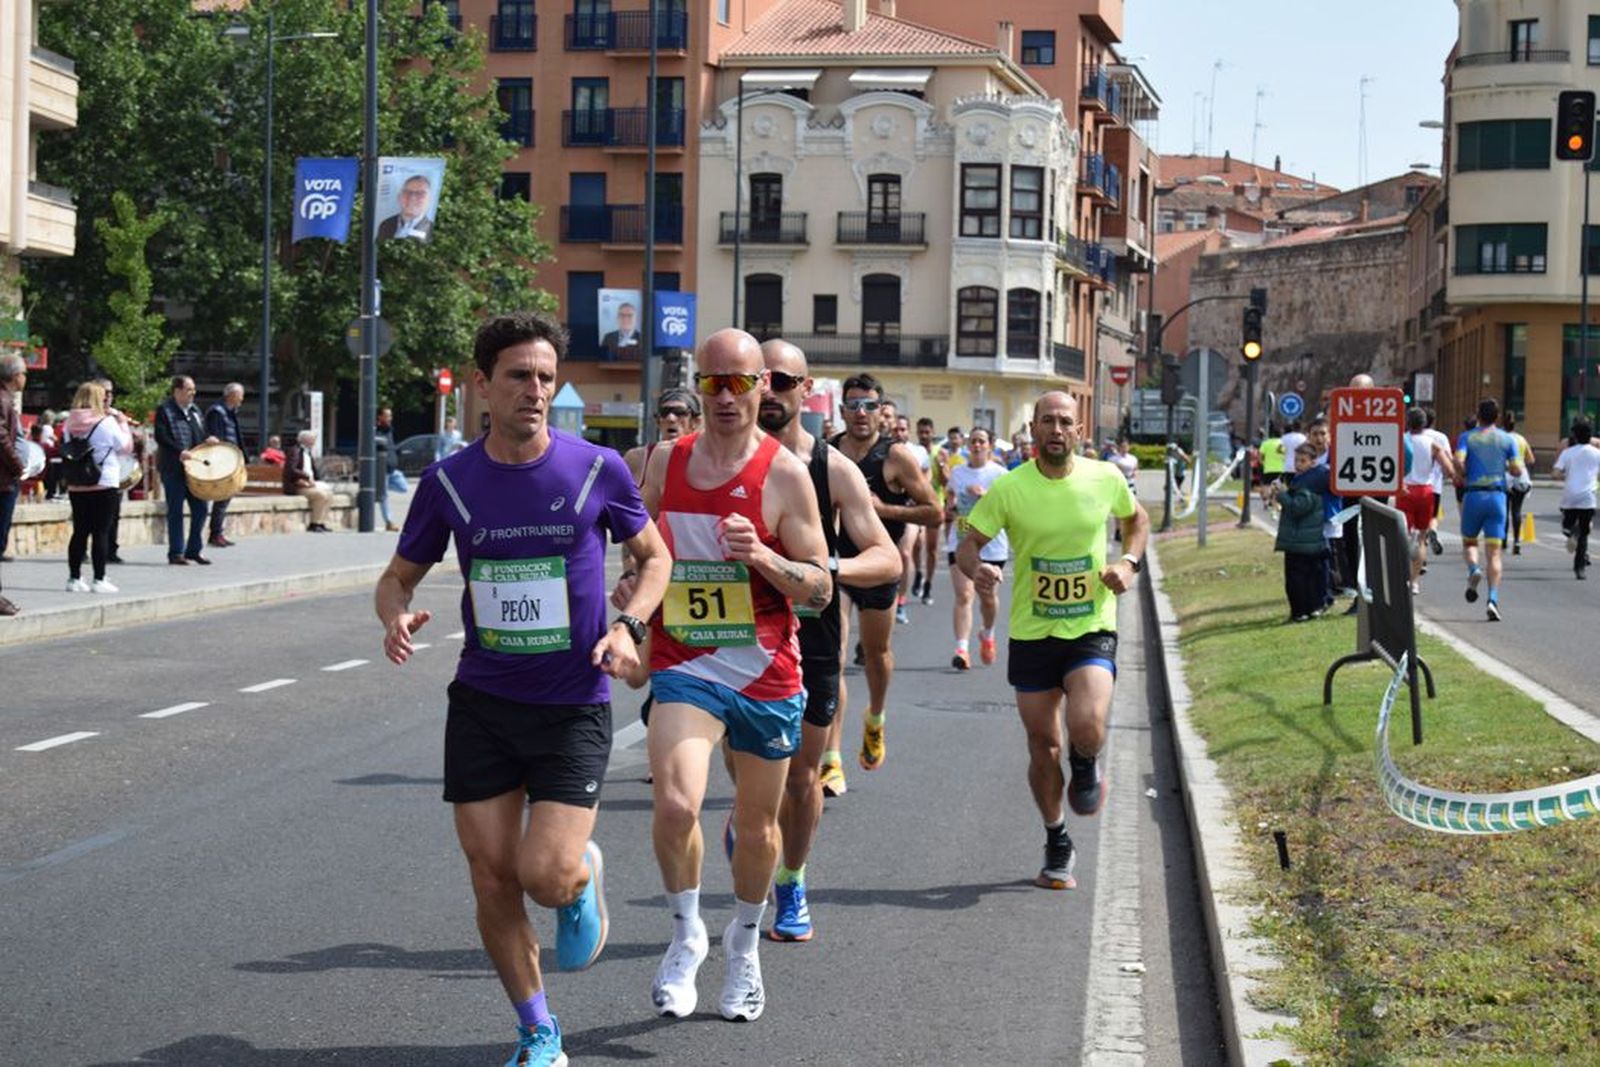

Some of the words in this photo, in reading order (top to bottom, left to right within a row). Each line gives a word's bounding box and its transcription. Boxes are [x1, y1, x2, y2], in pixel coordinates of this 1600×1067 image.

[304, 179, 342, 191] VOTA
[661, 306, 688, 316] VOTA
[1338, 396, 1397, 416] N-122
[1353, 431, 1381, 446] km
[1338, 456, 1395, 483] 459
[489, 525, 575, 540] FRONTRUNNER
[1038, 575, 1086, 601] 205
[501, 594, 541, 622] PEÓN
[688, 587, 726, 620] 51
[500, 635, 525, 646] CAJA
[527, 634, 564, 646] RURAL
[690, 630, 715, 639] CAJA
[717, 629, 750, 639] RURAL
